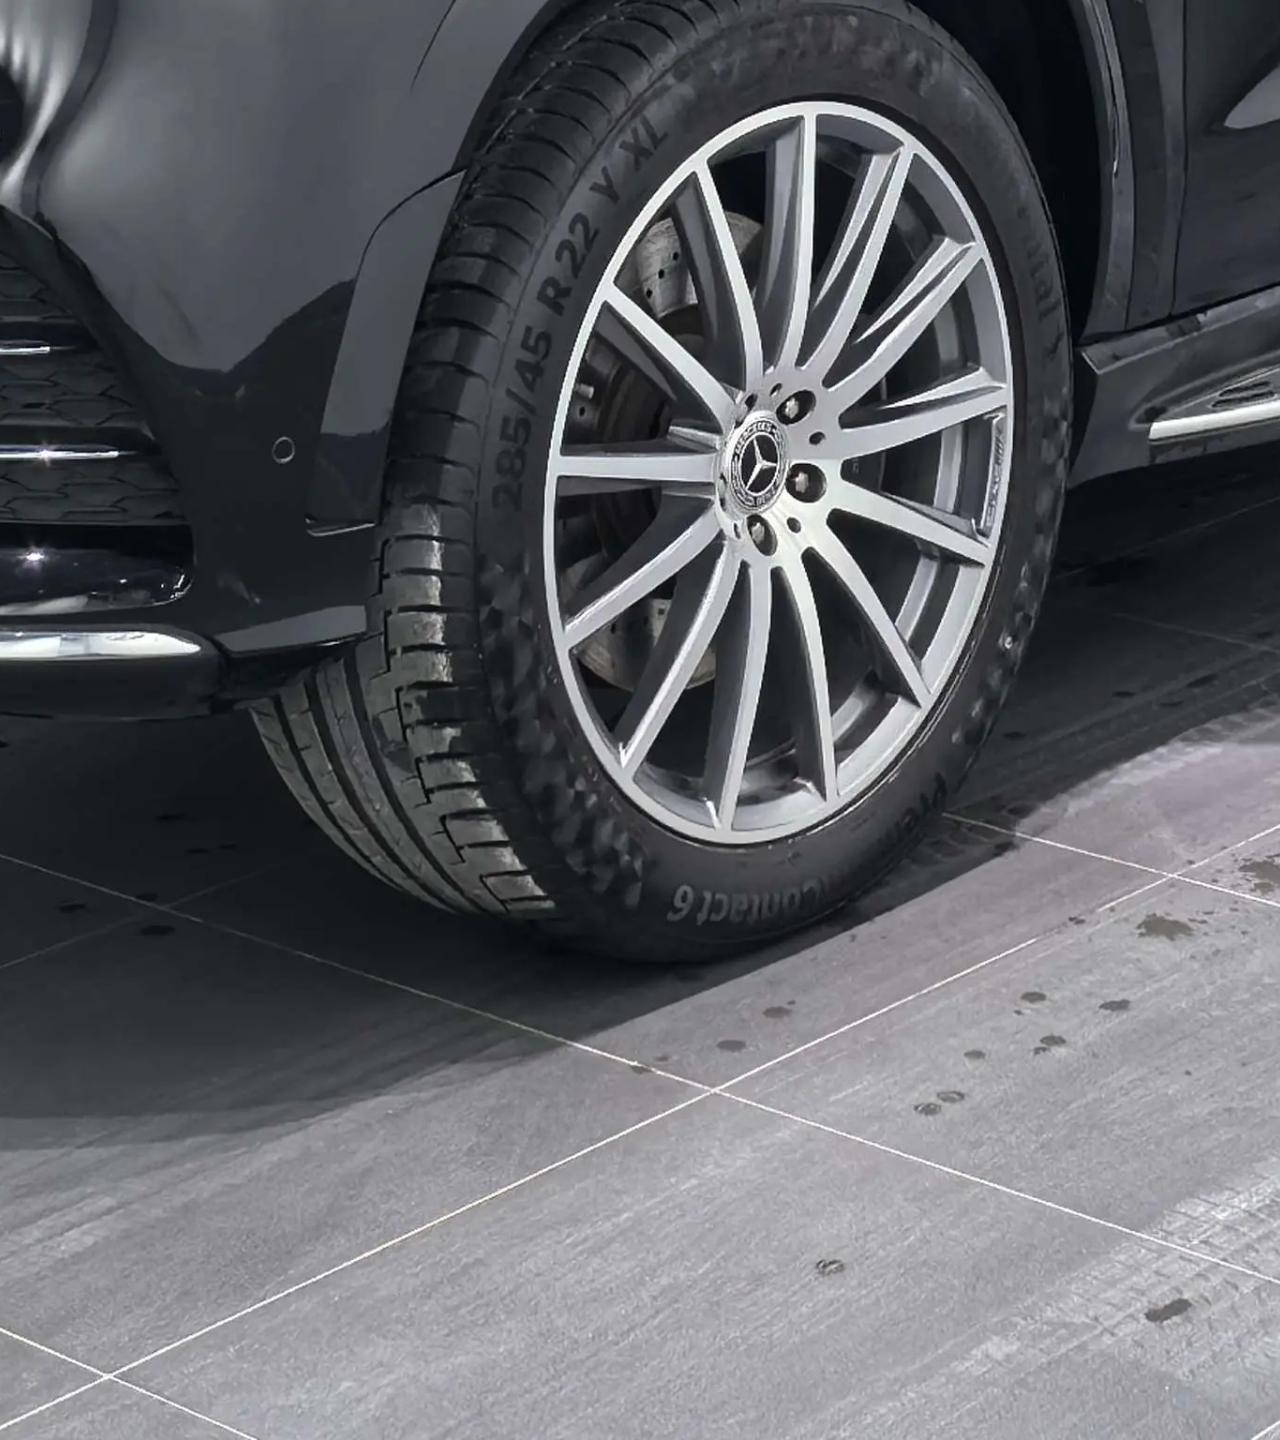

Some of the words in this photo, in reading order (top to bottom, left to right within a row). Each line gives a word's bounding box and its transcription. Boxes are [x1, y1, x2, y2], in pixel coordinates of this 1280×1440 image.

[619, 113, 670, 172] XL
[555, 212, 601, 279] 22
[537, 275, 574, 317] R
[492, 327, 553, 513] 285/45
